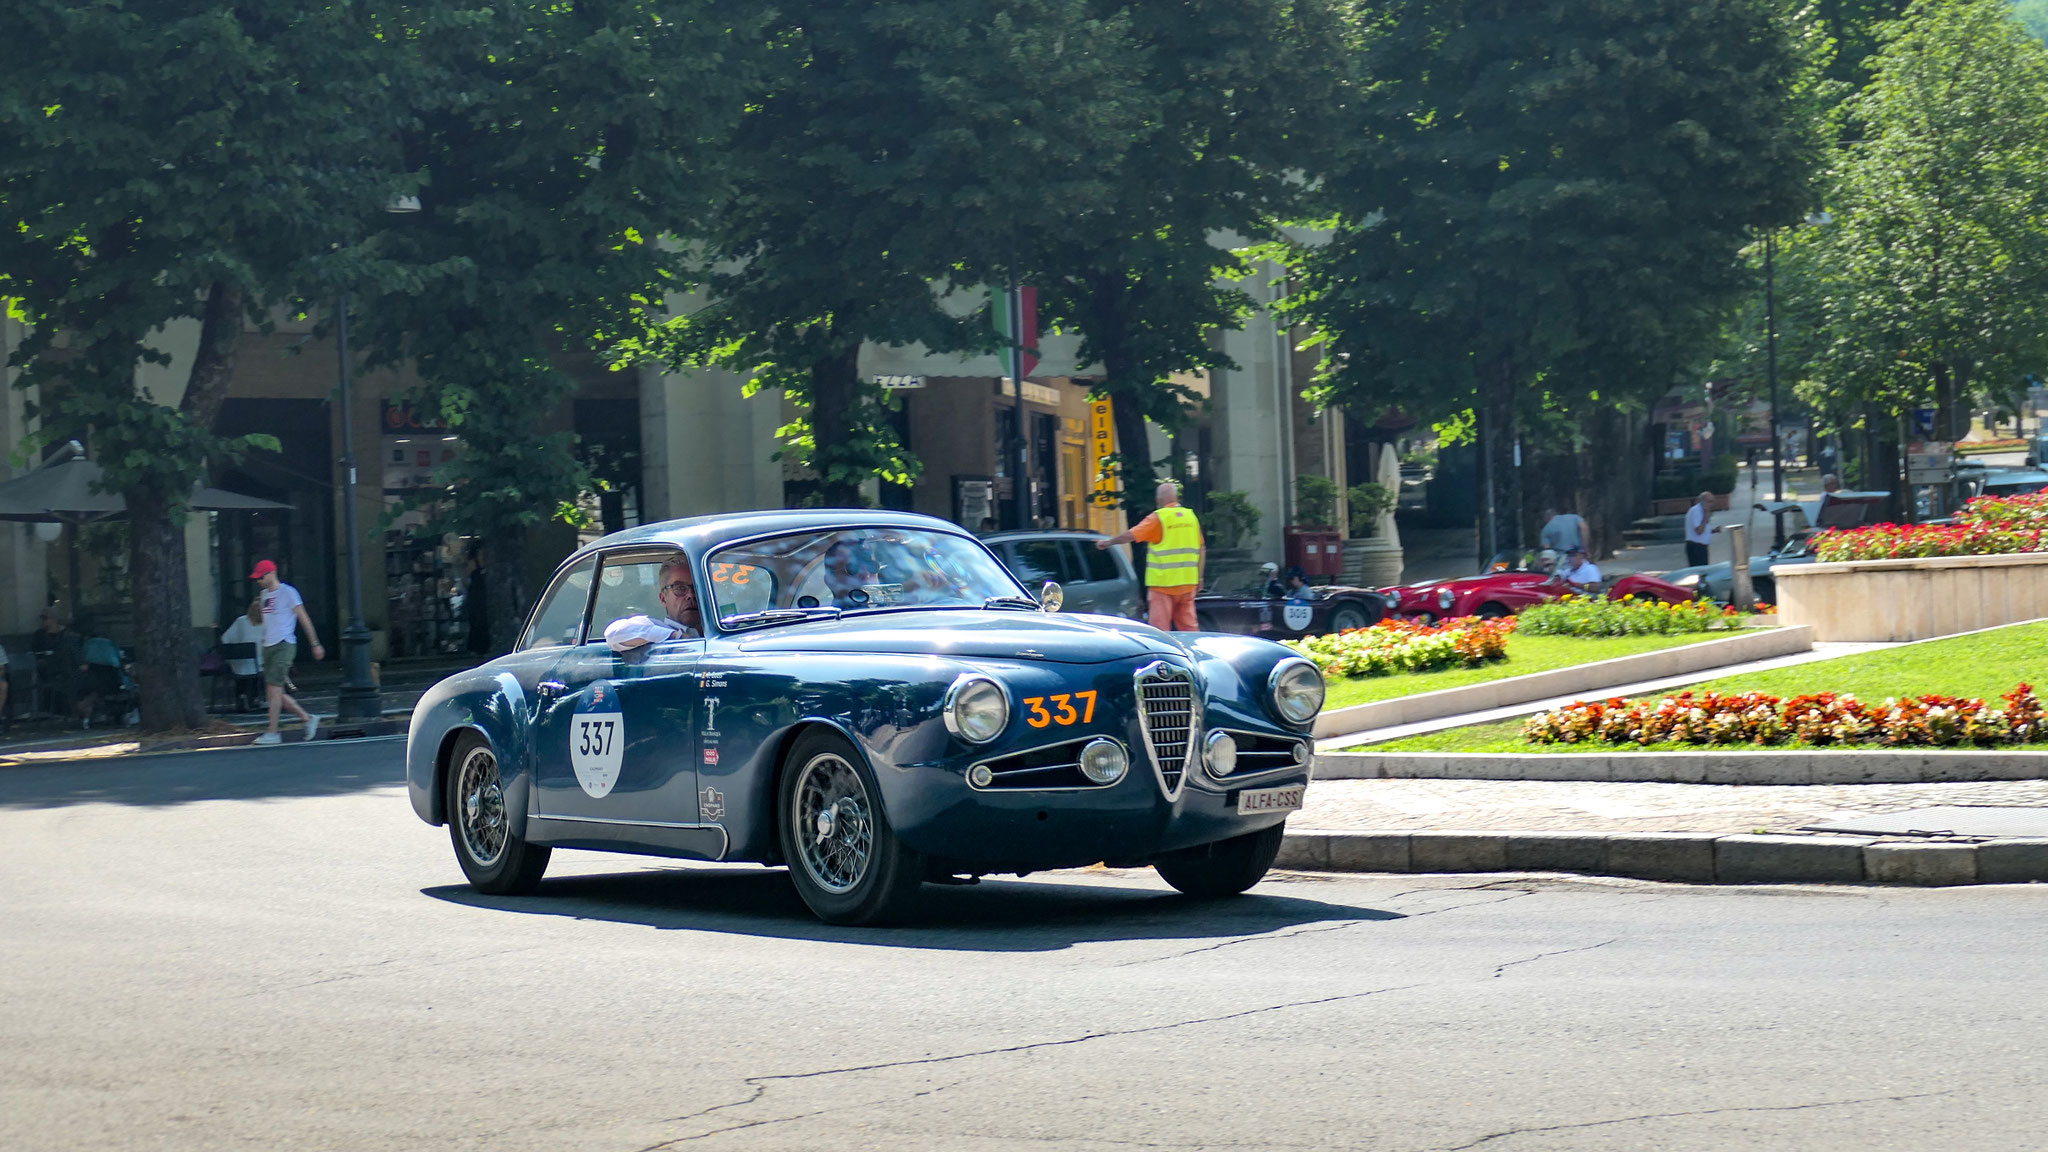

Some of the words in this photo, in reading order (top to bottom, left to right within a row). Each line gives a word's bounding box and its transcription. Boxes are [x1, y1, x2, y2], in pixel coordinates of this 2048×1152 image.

[1023, 690, 1097, 728] 337
[580, 721, 615, 756] 337
[1245, 791, 1298, 809] ALFA-CSS
